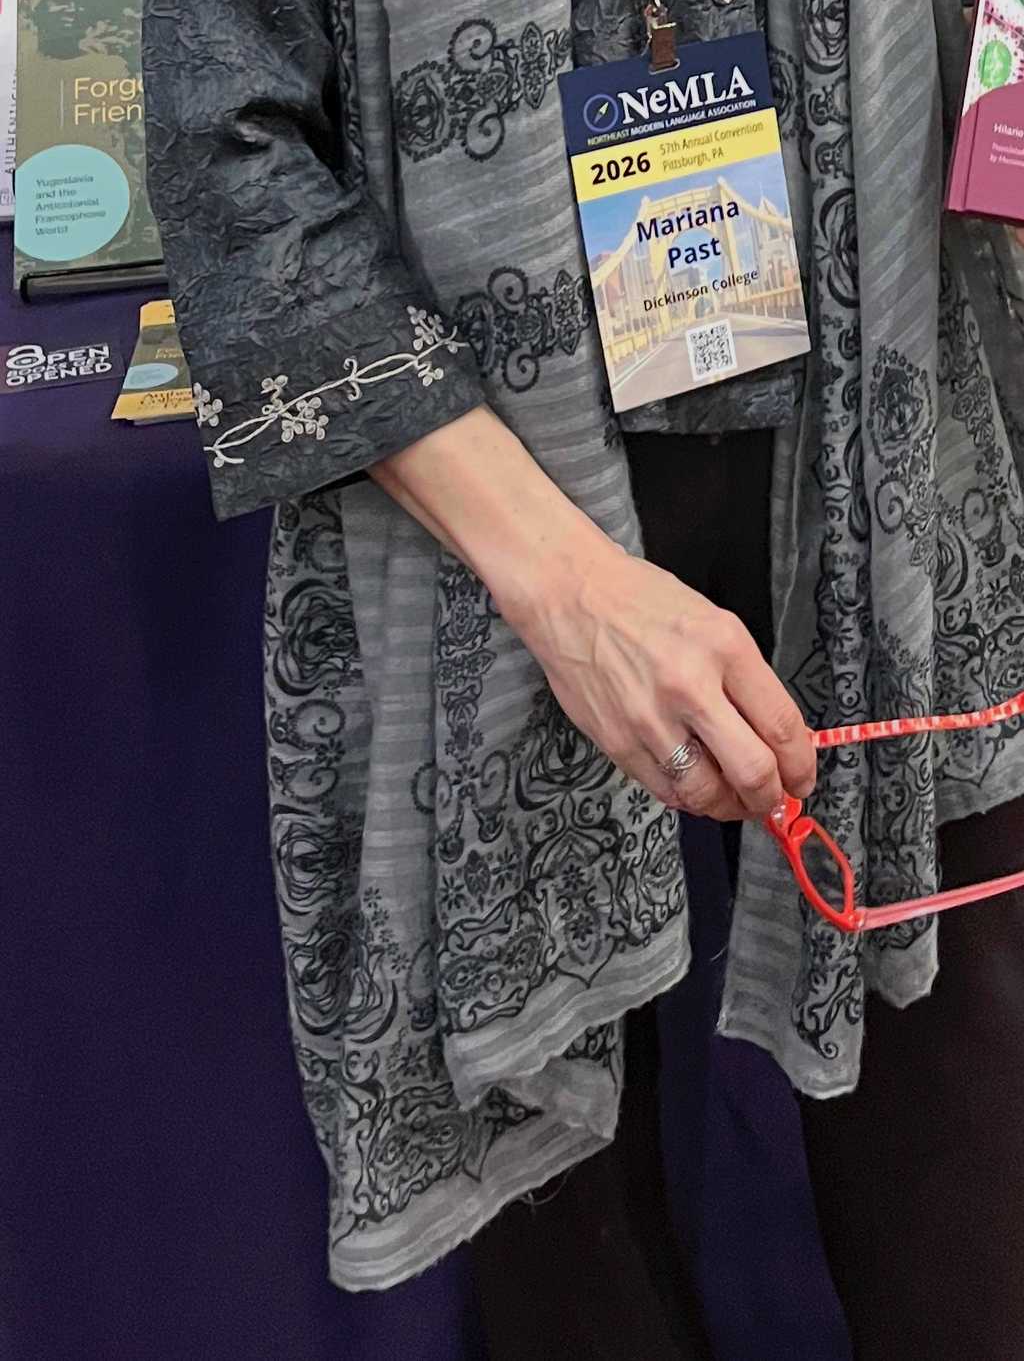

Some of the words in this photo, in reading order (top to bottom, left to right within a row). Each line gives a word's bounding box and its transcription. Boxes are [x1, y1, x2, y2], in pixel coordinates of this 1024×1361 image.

[617, 65, 754, 125] NeMLA
[75, 101, 142, 126] Frien
[587, 128, 630, 146] NORTHEAST
[630, 120, 665, 137] MODERN
[665, 111, 707, 132] LANGUAGE
[707, 99, 756, 118] ASSOCIATION
[660, 141, 681, 156] 57th
[682, 132, 713, 151] Annual
[714, 120, 764, 142] Convention
[993, 122, 1024, 138] Hilario
[590, 151, 651, 186] 2026
[662, 151, 711, 173] Pittsburgh,
[712, 147, 725, 160] PA
[36, 174, 94, 188] Yugoslavia
[35, 189, 55, 200] and
[59, 188, 77, 198] the
[35, 197, 100, 212] Anticolonial
[35, 210, 106, 225] Francophone
[636, 201, 739, 243] Mariana
[35, 225, 68, 236] World
[667, 237, 721, 269] Past
[643, 284, 709, 312] Dickinson
[712, 269, 759, 292] College
[6, 344, 109, 369] OPEN
[6, 362, 112, 386] OPENED
